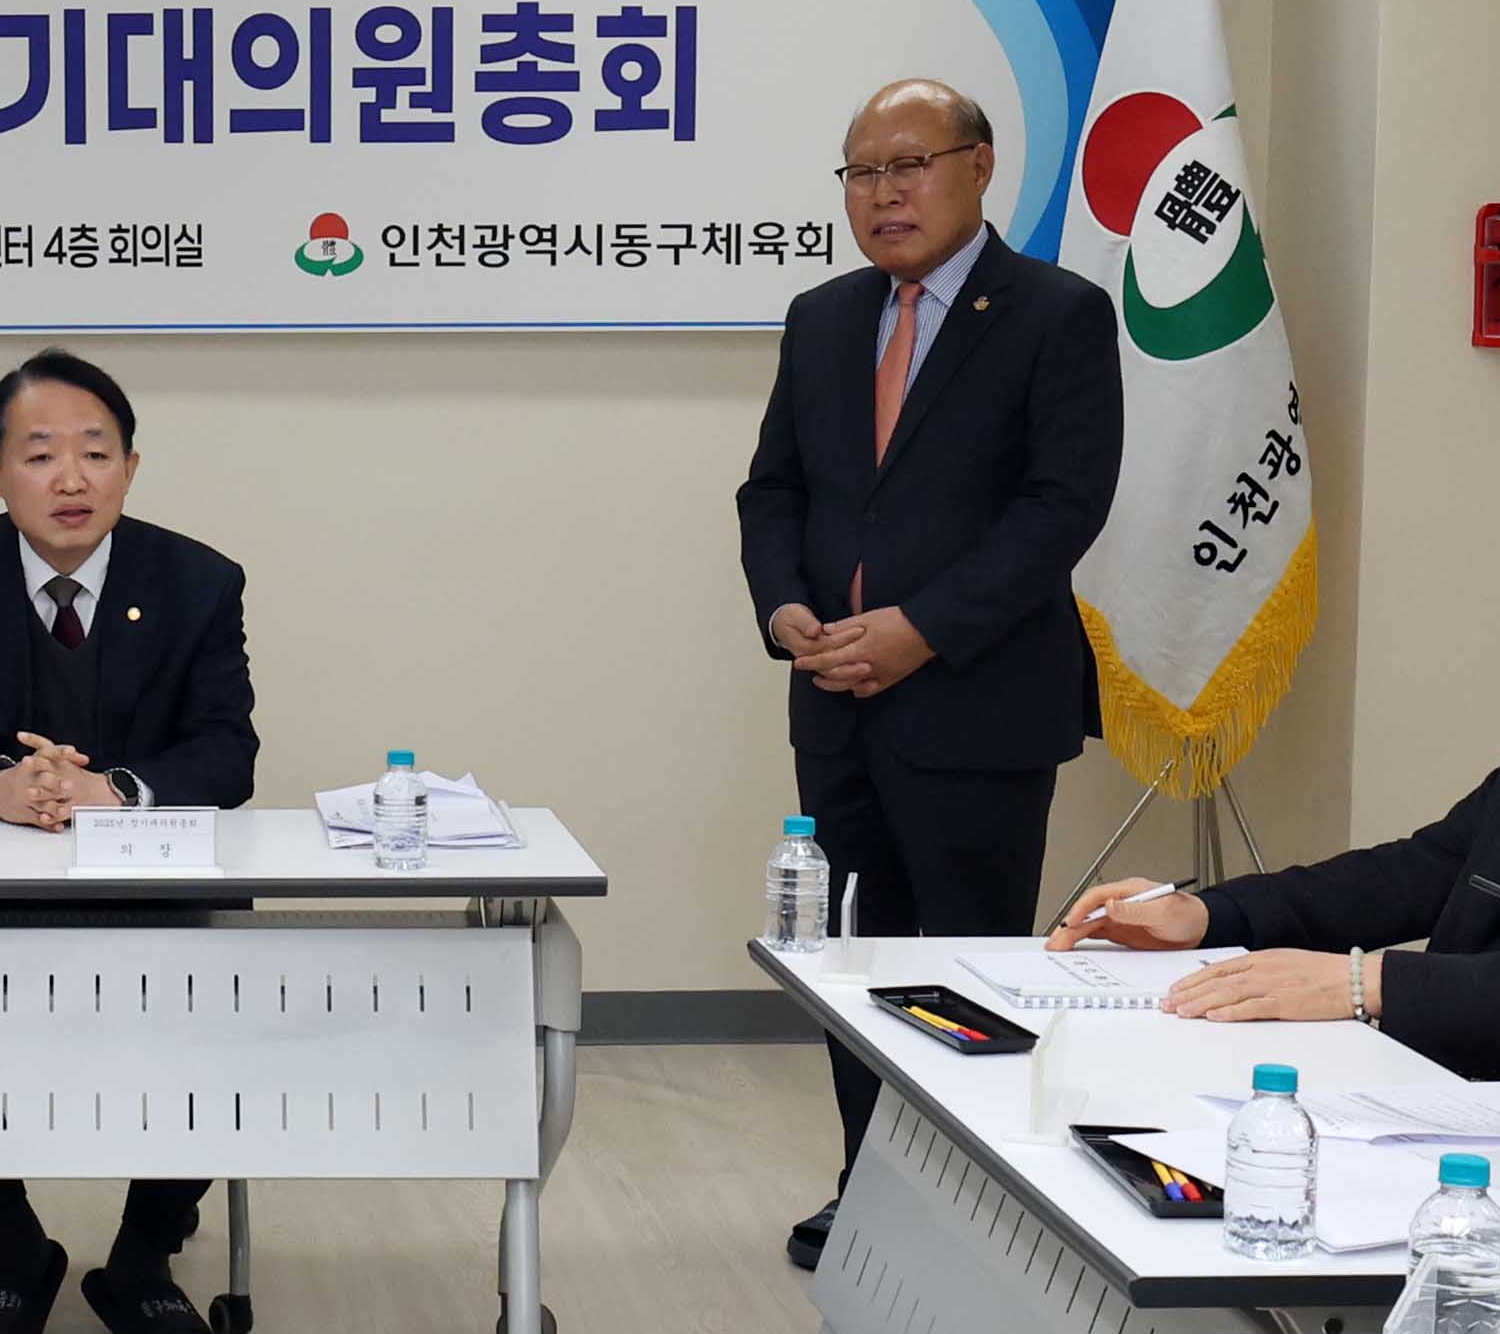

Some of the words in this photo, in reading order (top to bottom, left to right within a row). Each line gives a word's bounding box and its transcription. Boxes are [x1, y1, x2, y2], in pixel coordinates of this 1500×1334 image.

[42, 223, 100, 271] 4층
[107, 222, 203, 271] 회의실
[380, 221, 834, 269] 인천광역시동구체육회
